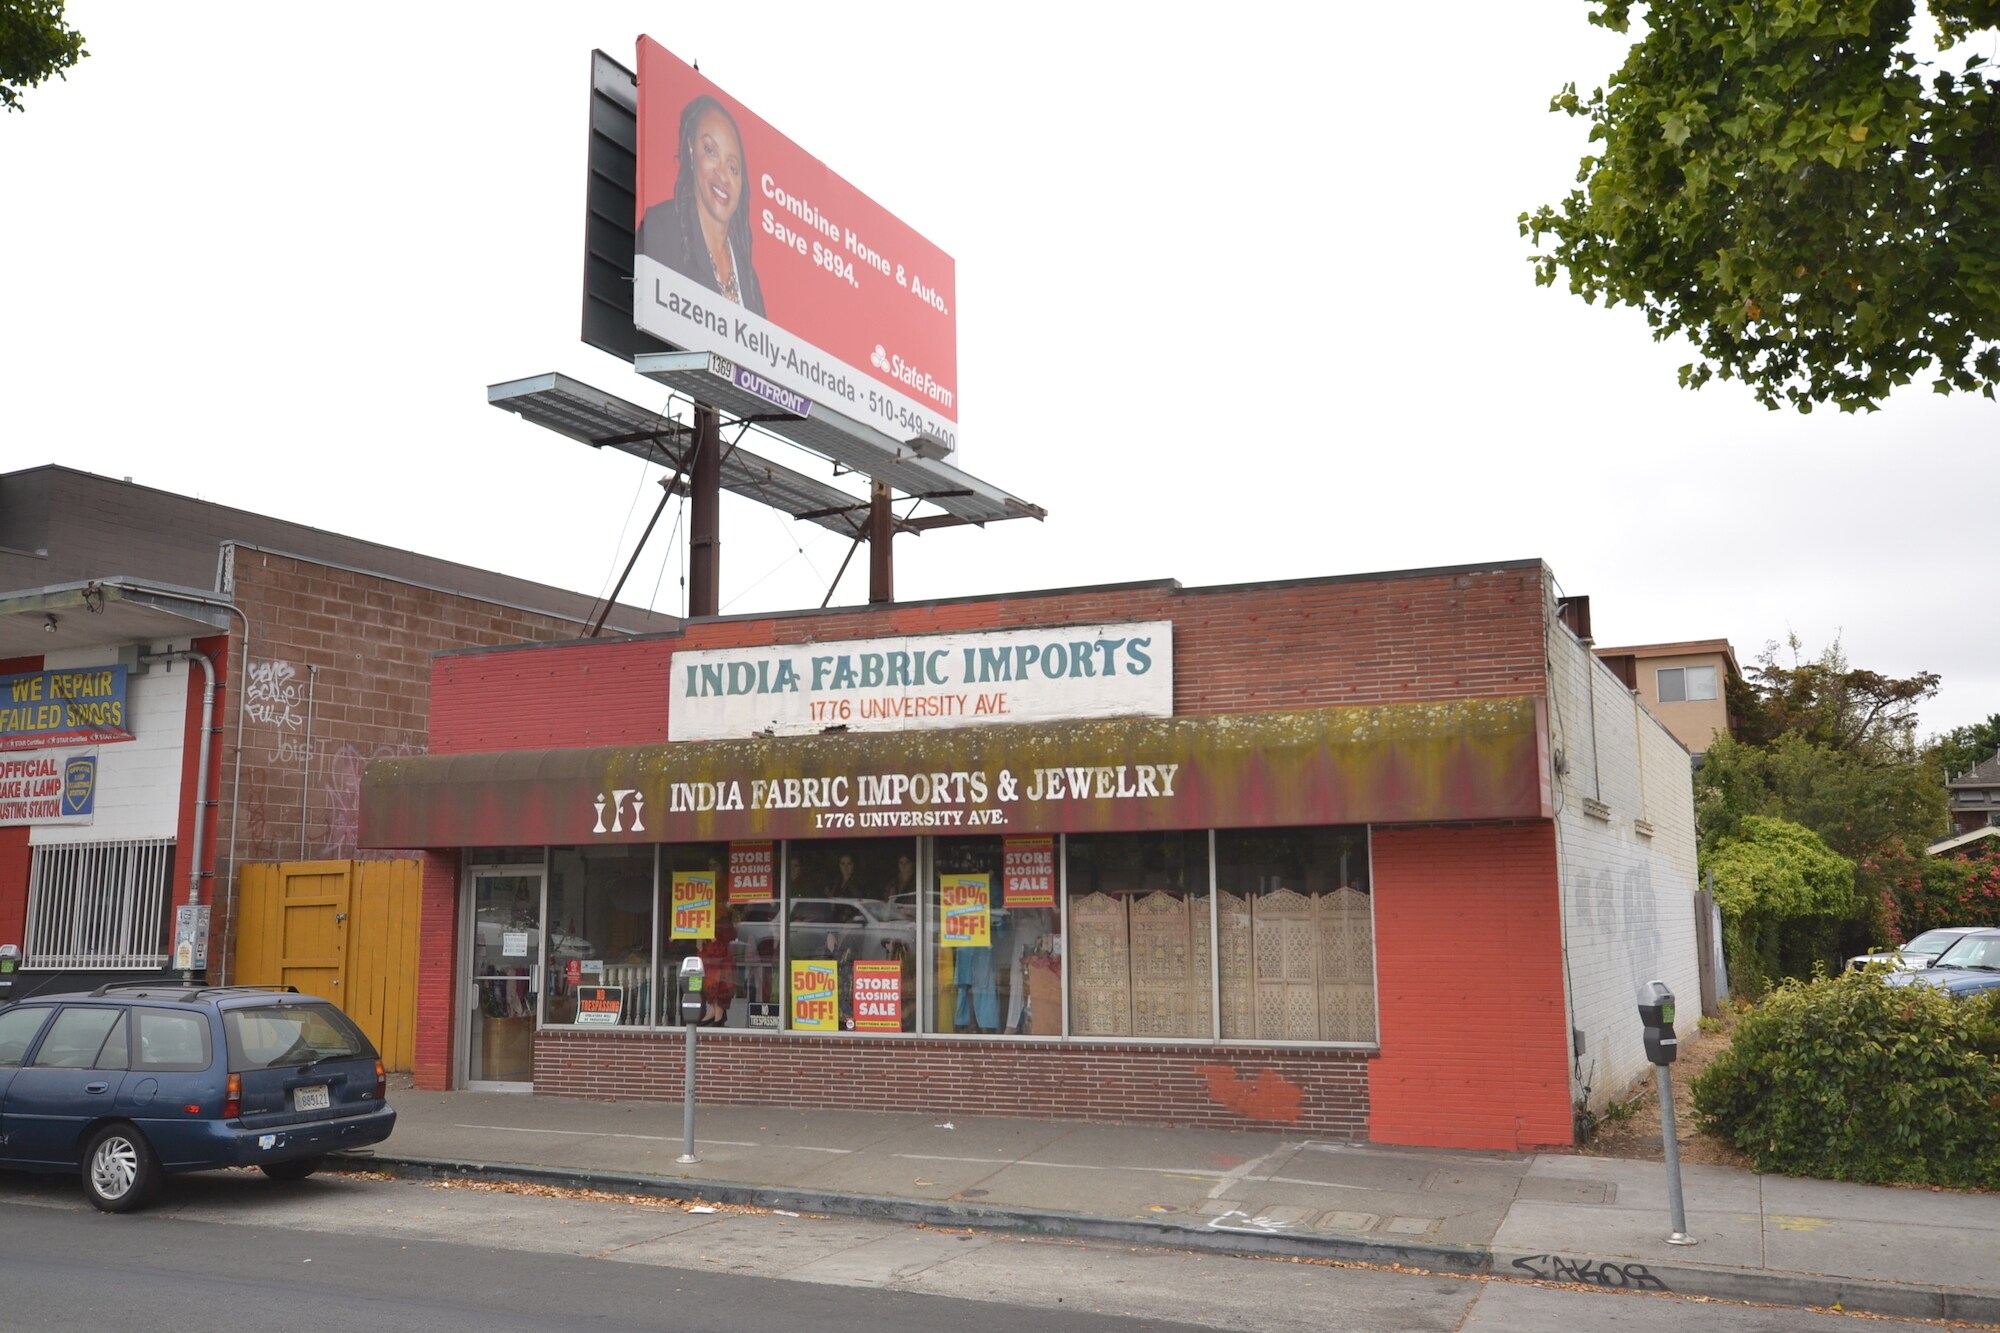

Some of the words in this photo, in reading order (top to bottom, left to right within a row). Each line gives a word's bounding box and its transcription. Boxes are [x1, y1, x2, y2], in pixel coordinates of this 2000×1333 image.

[761, 174, 840, 242] Combine
[845, 228, 891, 276] Home
[896, 264, 907, 287] &
[911, 275, 948, 315] Auto.
[762, 209, 807, 255] Save
[812, 240, 859, 289] $894.
[655, 278, 728, 338] Lazena
[735, 318, 856, 402] Kelly-Andrada
[712, 355, 732, 378] 1369
[740, 371, 804, 412] OUTFRONT
[685, 659, 800, 698] INDIA
[811, 650, 949, 691] FABRIC
[963, 637, 1152, 684] IMPORTS
[12, 676, 43, 703] WE
[49, 671, 113, 700] REPAIR
[0, 704, 61, 732] FAILED
[66, 701, 122, 728] SMOGS
[810, 699, 851, 721] 1776
[860, 694, 967, 719] UNIVERSITY
[975, 693, 1011, 715] AVE.
[0, 759, 57, 779] OFFICIAL
[24, 781, 30, 797] &
[33, 778, 61, 797] LAMP
[670, 781, 744, 812] INDIA
[751, 775, 849, 810] FABRIC
[857, 771, 988, 806] IMPORTS
[997, 769, 1019, 801] &
[1026, 764, 1179, 801] JEWELRY
[29, 799, 60, 818] STATION
[815, 812, 855, 828] 1776
[859, 810, 963, 828] UNIVERSITY
[967, 809, 1009, 825] AVE.
[731, 852, 771, 864] STORE
[1006, 852, 1051, 865] STORE
[730, 864, 771, 874] CLOSING
[1005, 866, 1052, 876] CLOSING
[734, 875, 768, 888] SALE
[1010, 877, 1048, 890] SALE
[674, 882, 713, 901] 50%
[943, 886, 988, 906] 50%
[676, 910, 711, 928] OFF!
[945, 915, 985, 935] OFF!
[794, 971, 835, 991] 50%
[856, 978, 899, 990] STORE
[596, 989, 605, 1000] NO
[855, 992, 899, 1001] CLOSING
[581, 1000, 620, 1012] TRESPASSING
[761, 1004, 769, 1015] NO
[796, 1001, 834, 1020] OFF!
[859, 1002, 895, 1016] SALE
